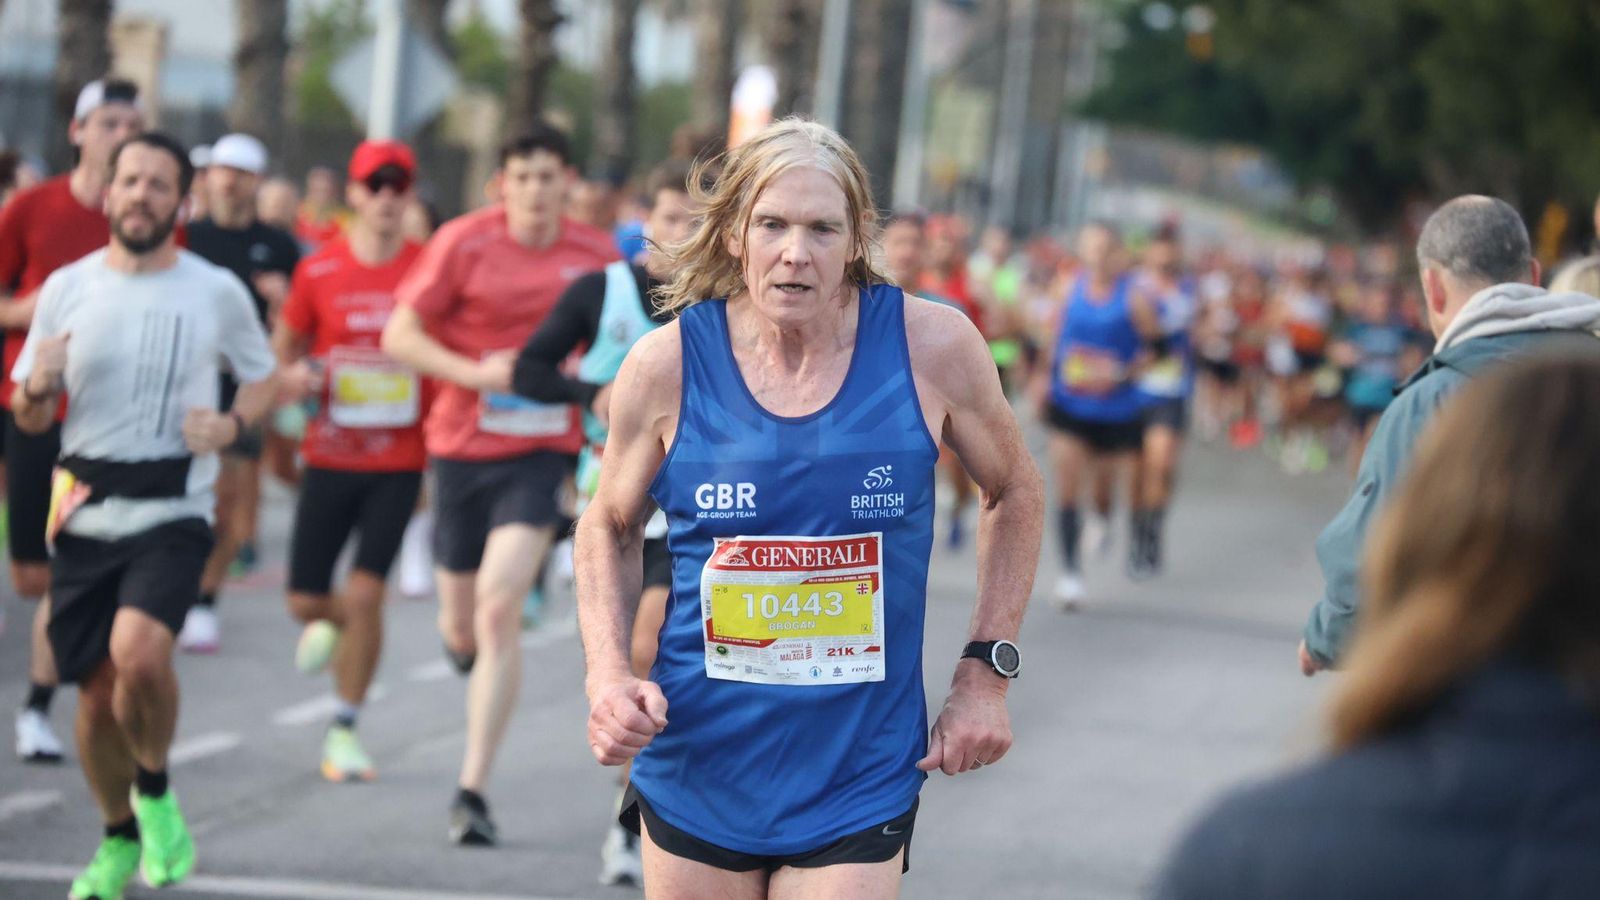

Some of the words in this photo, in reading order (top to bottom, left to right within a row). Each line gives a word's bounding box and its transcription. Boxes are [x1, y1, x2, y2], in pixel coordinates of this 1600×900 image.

[695, 482, 757, 510] GBR
[851, 493, 904, 508] BRITISH
[735, 510, 757, 518] TEAM
[852, 508, 904, 519] TRIATHLON
[751, 543, 867, 567] GENERALI
[741, 591, 844, 620] 10443
[768, 621, 816, 631] BROGAN
[827, 647, 854, 657] 21K
[851, 664, 875, 674] renfe
